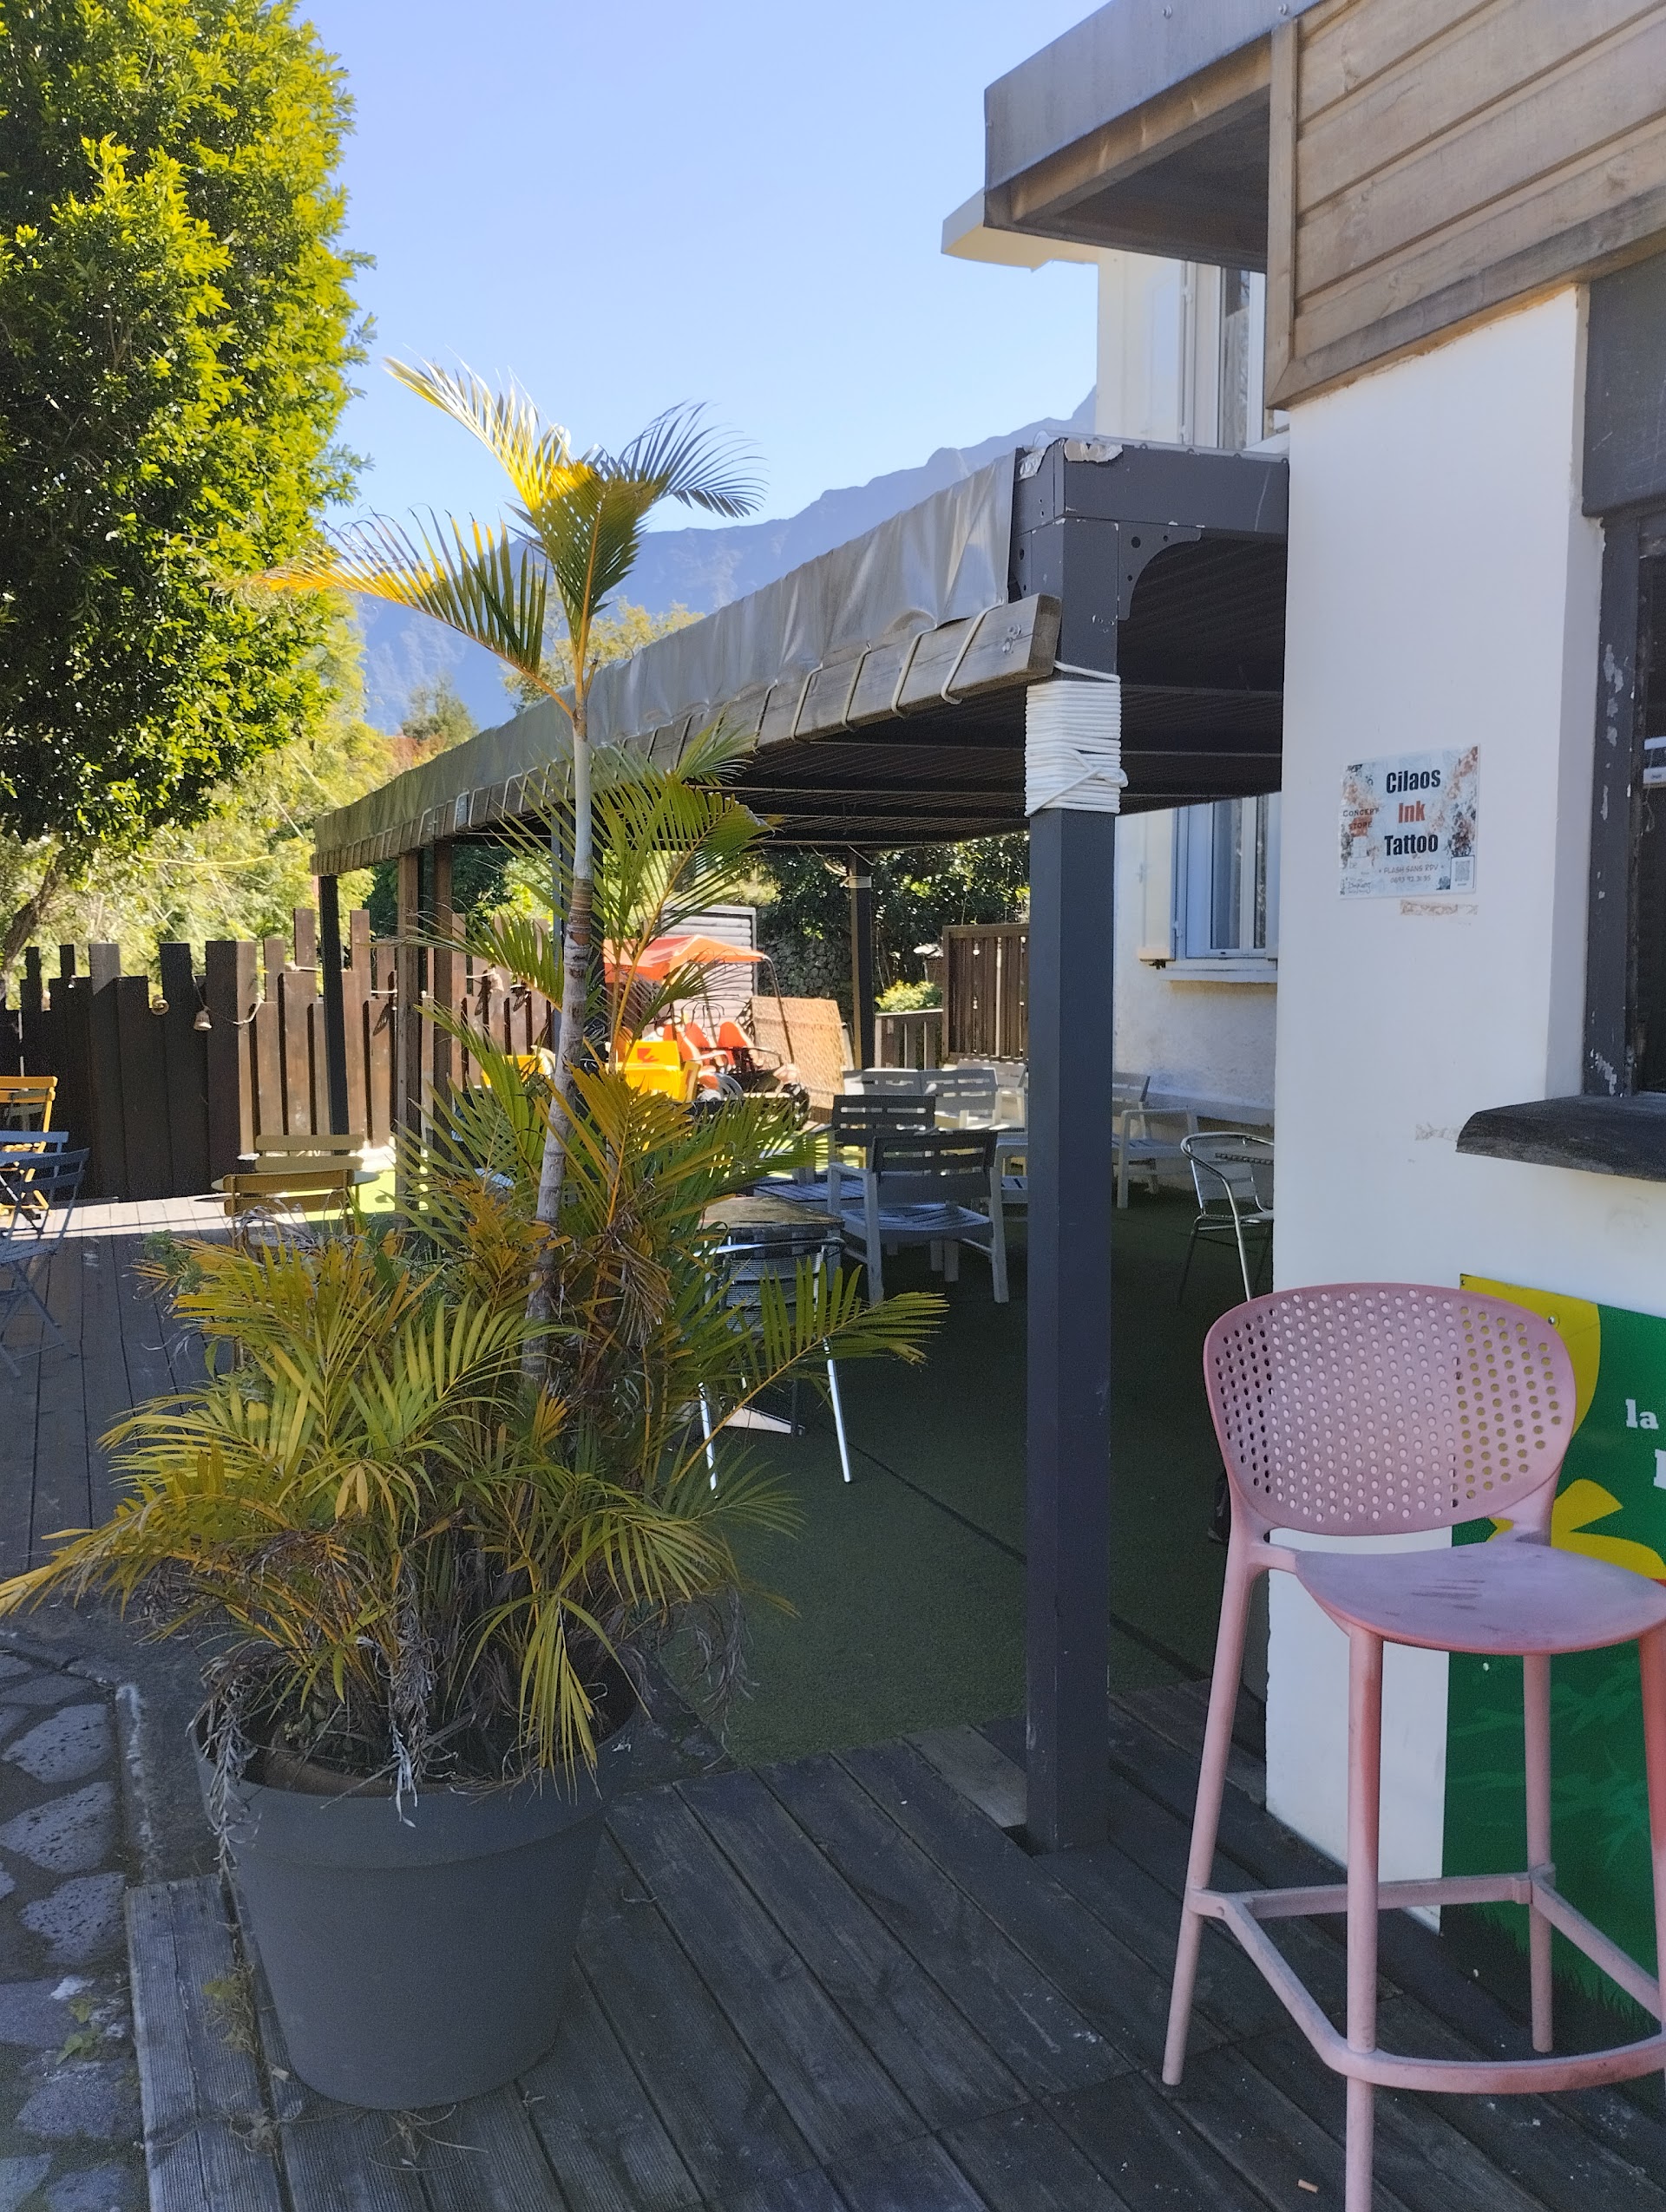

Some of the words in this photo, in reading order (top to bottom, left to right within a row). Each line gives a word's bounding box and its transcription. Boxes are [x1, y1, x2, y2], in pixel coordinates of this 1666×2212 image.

[1386, 769, 1441, 794] Cilaos
[1342, 808, 1380, 817] CONCEPT
[1398, 801, 1426, 823] Ink
[1348, 821, 1373, 830] STORE
[1384, 834, 1439, 856] Tattoo
[1625, 1398, 1659, 1430] la
